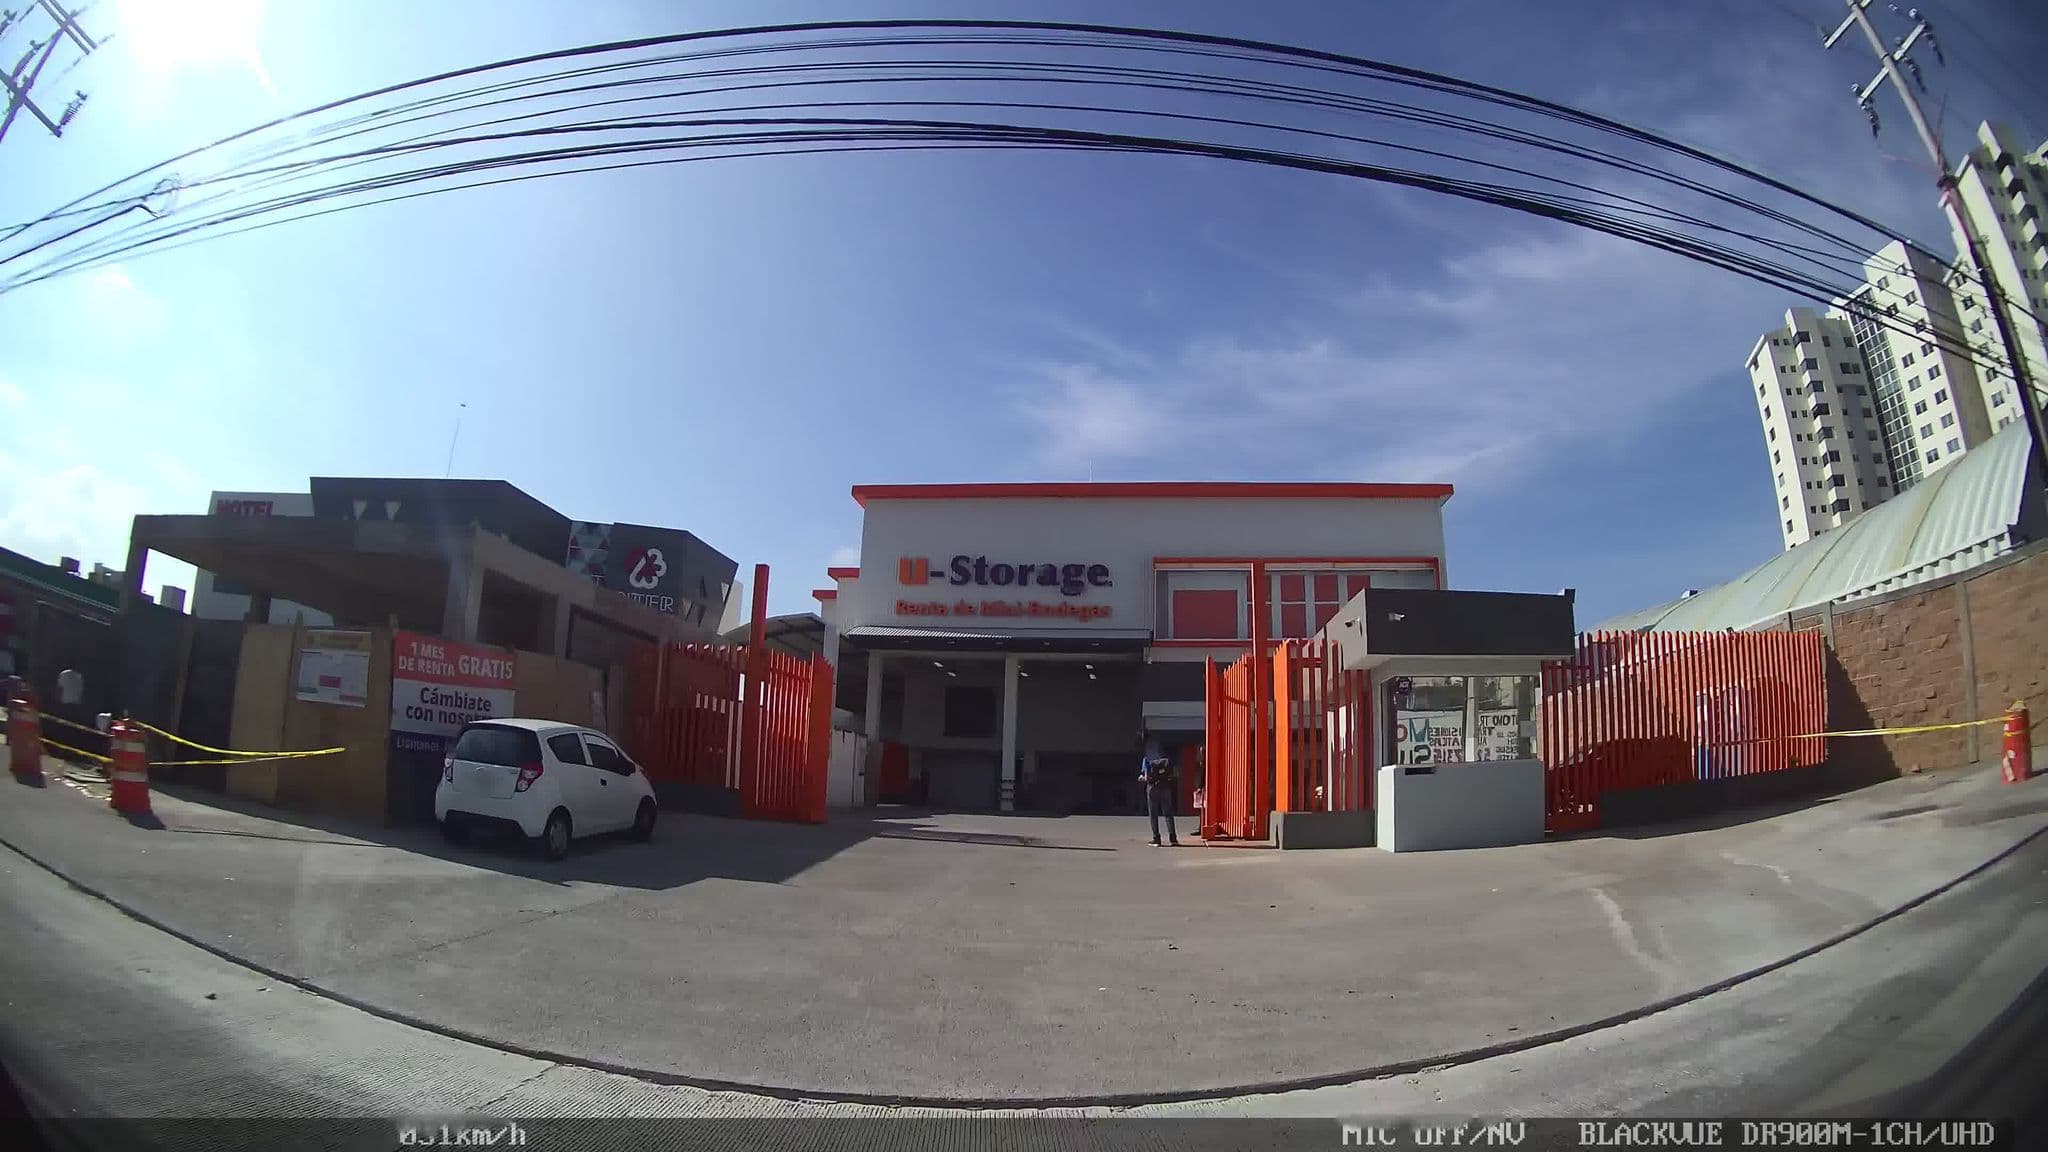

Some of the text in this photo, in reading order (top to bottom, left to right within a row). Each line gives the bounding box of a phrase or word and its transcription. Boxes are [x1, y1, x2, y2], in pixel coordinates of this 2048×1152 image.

[896, 600, 948, 616] Renta
[954, 599, 976, 616] de
[410, 642, 444, 659] 1 MES
[399, 656, 455, 676] DE RENTA
[458, 655, 513, 679] GRATIS
[420, 687, 492, 712] Cámbiate
[405, 705, 433, 722] con
